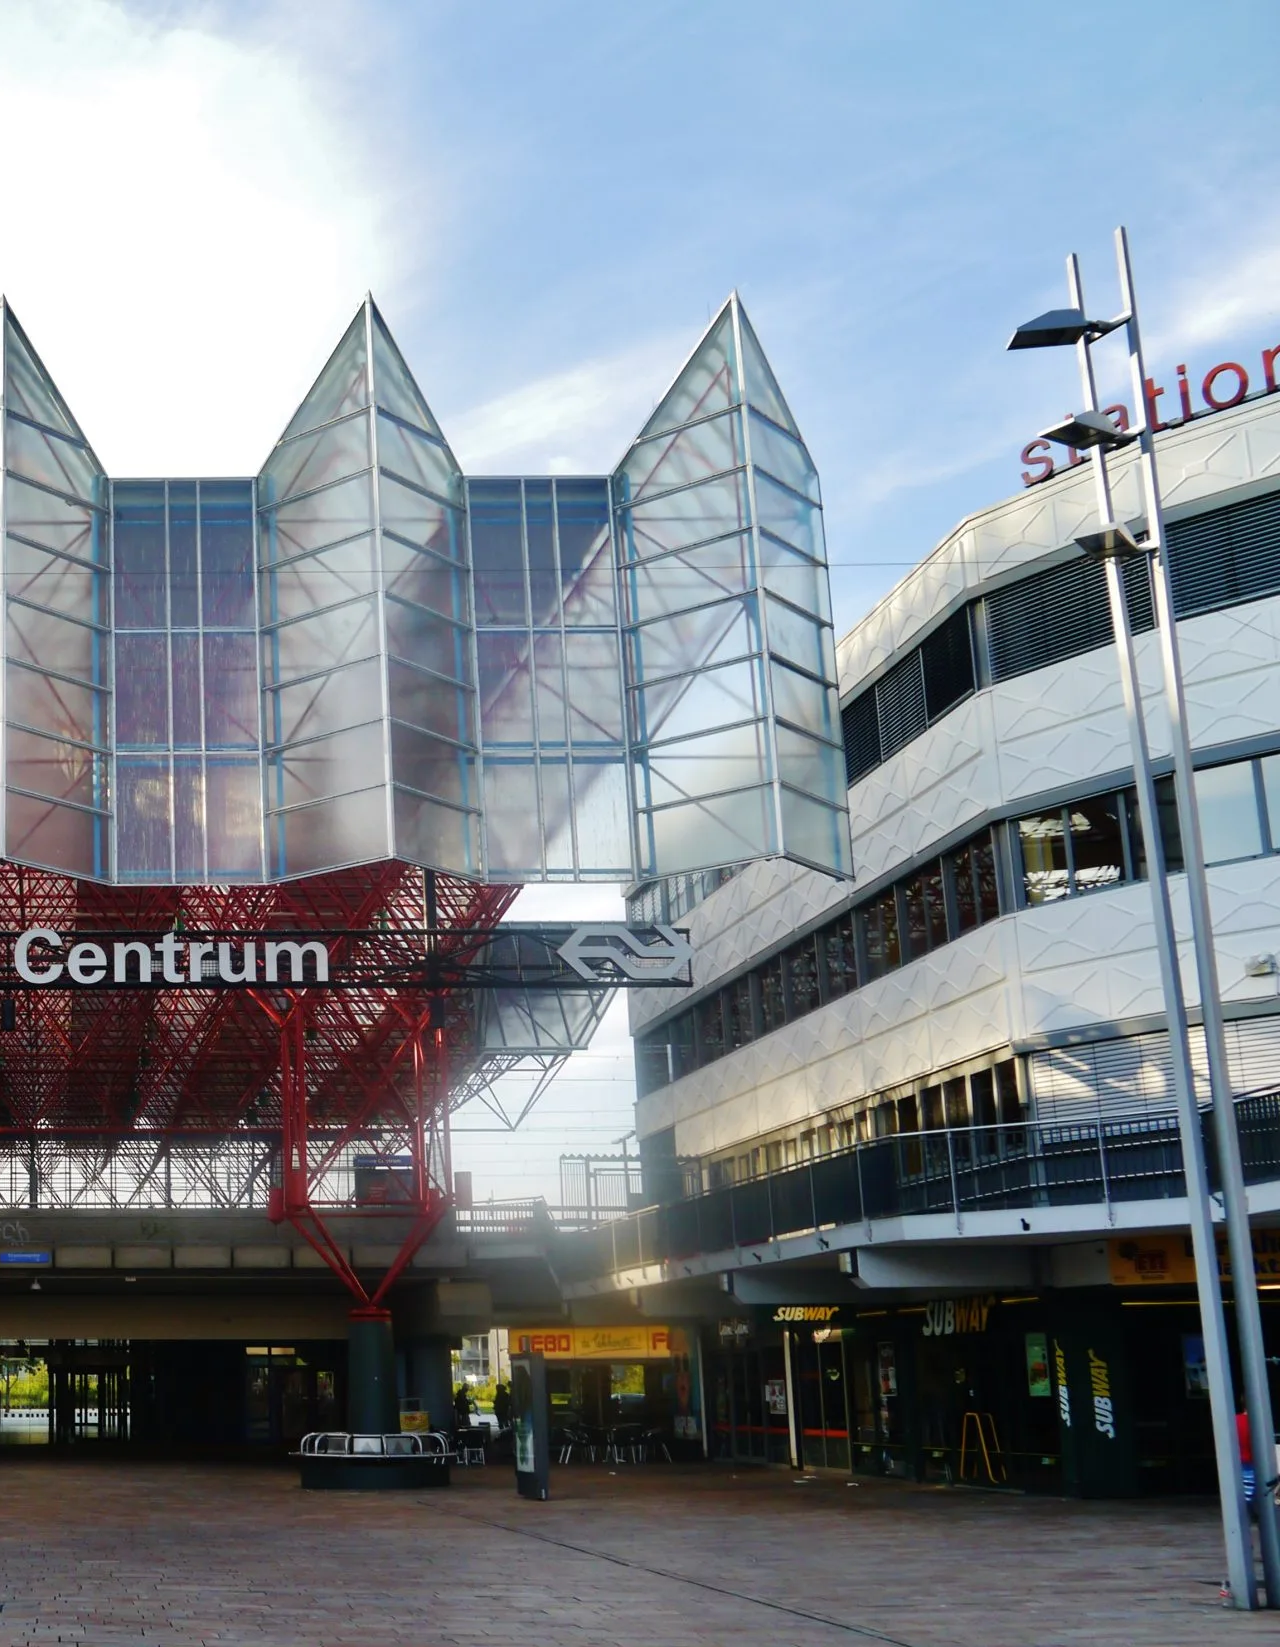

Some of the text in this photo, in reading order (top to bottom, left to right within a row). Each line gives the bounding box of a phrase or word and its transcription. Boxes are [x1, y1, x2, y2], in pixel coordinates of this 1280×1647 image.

[13, 927, 329, 985] Centrum
[772, 1306, 840, 1322] SUBWAY
[922, 1295, 996, 1337] SUBWAY
[1052, 1337, 1072, 1429] SUBWAY
[1086, 1347, 1116, 1440] SUBWAY
